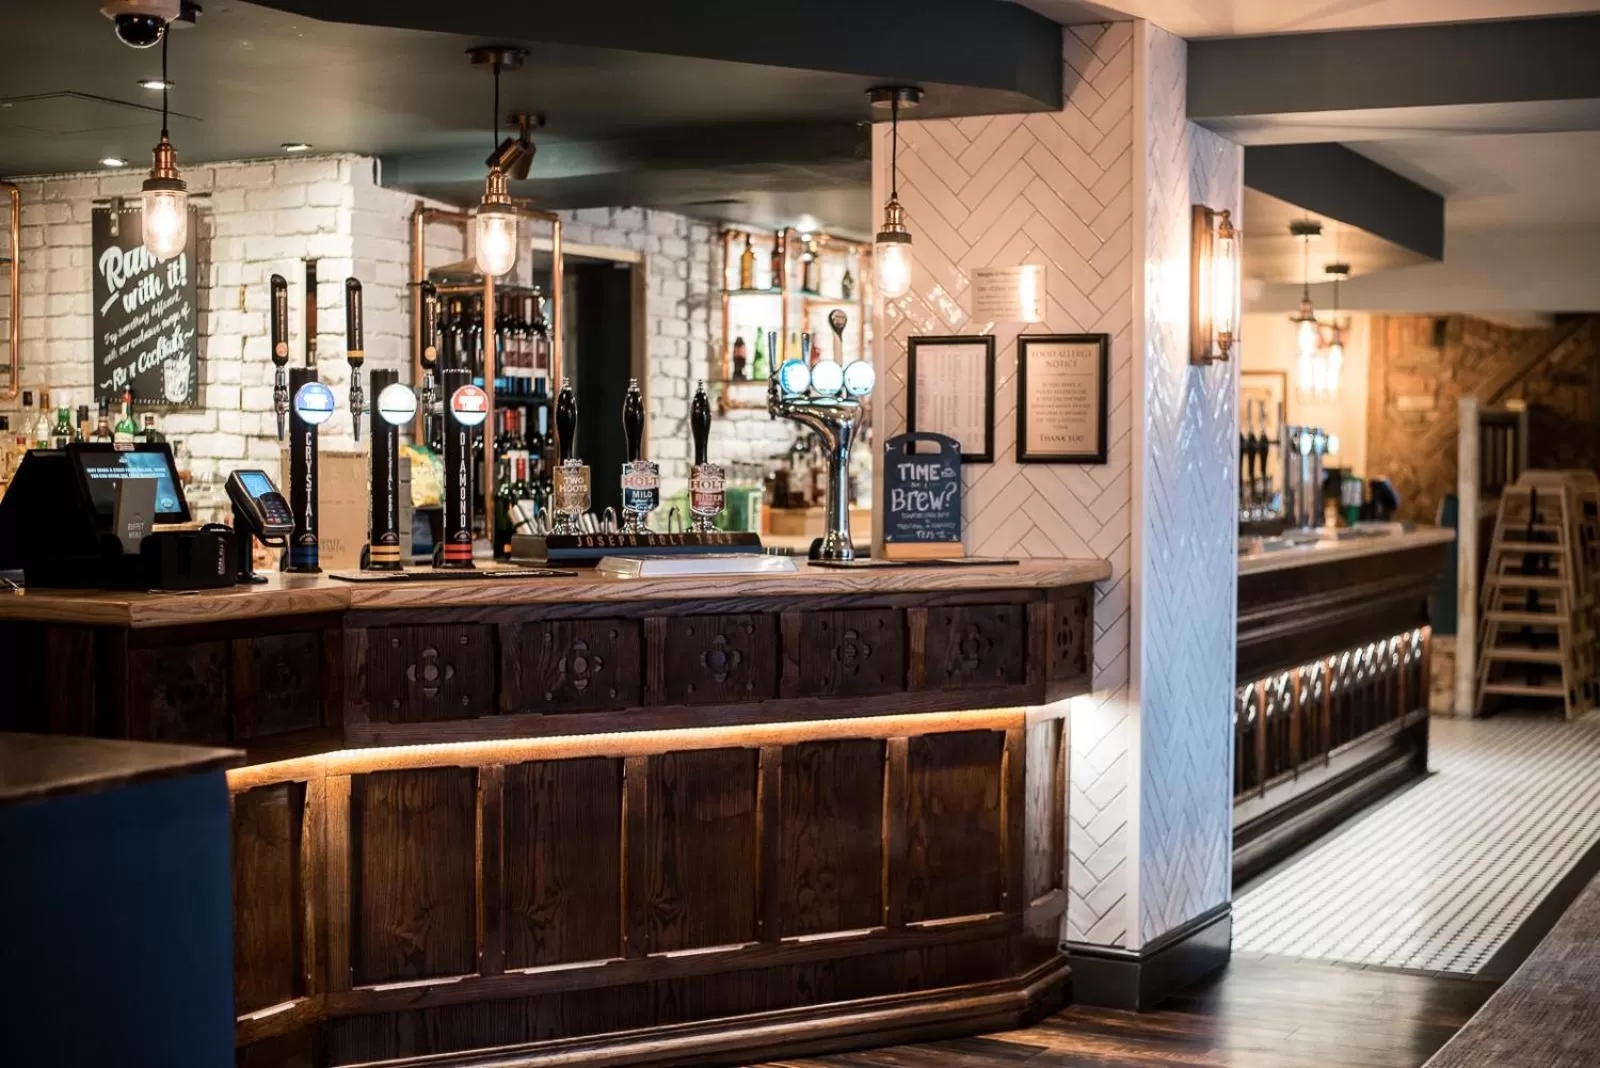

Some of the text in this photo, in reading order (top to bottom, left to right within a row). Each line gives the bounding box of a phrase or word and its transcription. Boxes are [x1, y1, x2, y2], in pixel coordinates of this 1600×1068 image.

[123, 252, 187, 313] with it!
[137, 324, 185, 373] Cocktails
[459, 431, 467, 528] DIAMOND
[897, 462, 941, 481] TIME
[305, 431, 313, 531] CRYSTAL
[560, 485, 588, 493] HOOTS
[564, 477, 584, 485] TWO
[624, 475, 658, 487] HOLT
[691, 479, 724, 489] HOLT
[632, 490, 653, 500] MILD
[891, 481, 957, 512] Brew?
[577, 534, 637, 547] JOSEPH
[648, 533, 685, 546] HOLT
